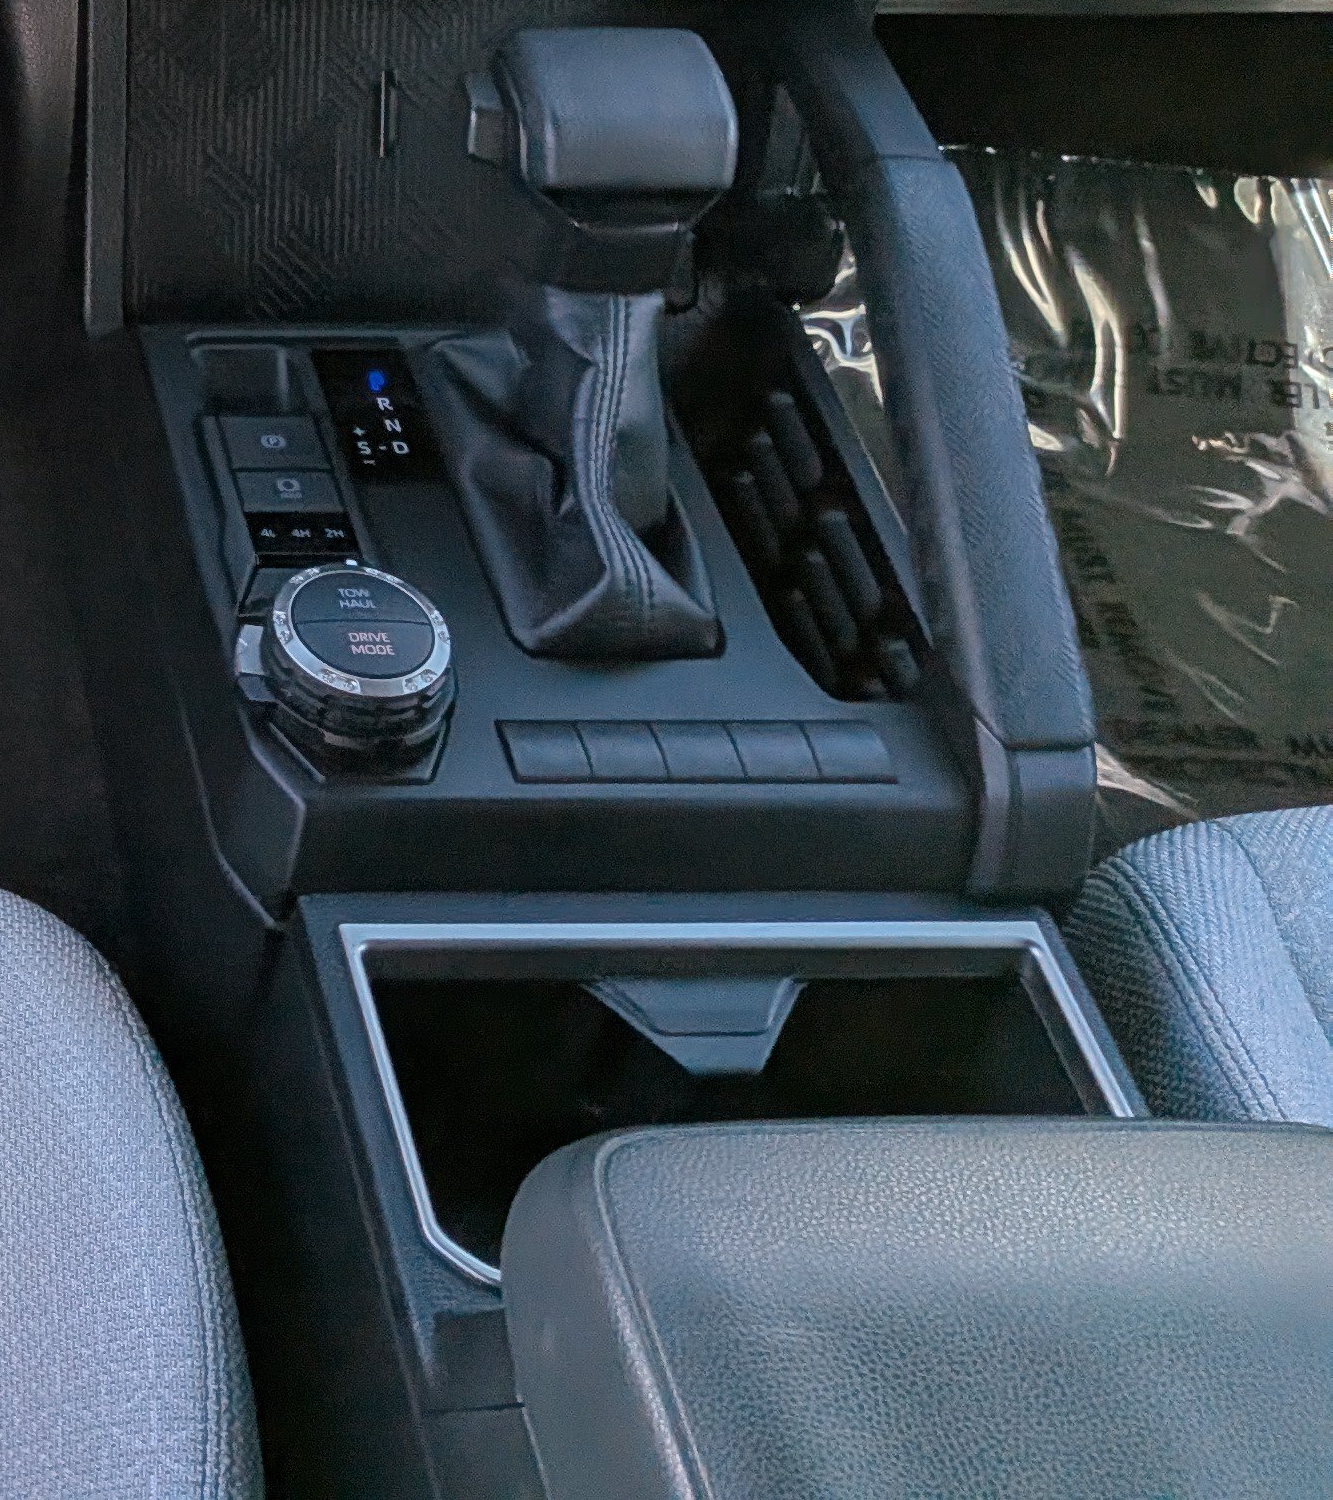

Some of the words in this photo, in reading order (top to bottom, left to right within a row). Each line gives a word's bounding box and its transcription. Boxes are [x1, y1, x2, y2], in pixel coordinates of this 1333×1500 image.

[376, 397, 394, 411] R
[384, 418, 402, 433] N
[357, 441, 372, 455] S
[391, 441, 410, 455] D
[337, 588, 370, 599] TOW
[339, 599, 377, 609] HAUL
[348, 632, 391, 643] DRIVE
[350, 644, 396, 656] MODE
